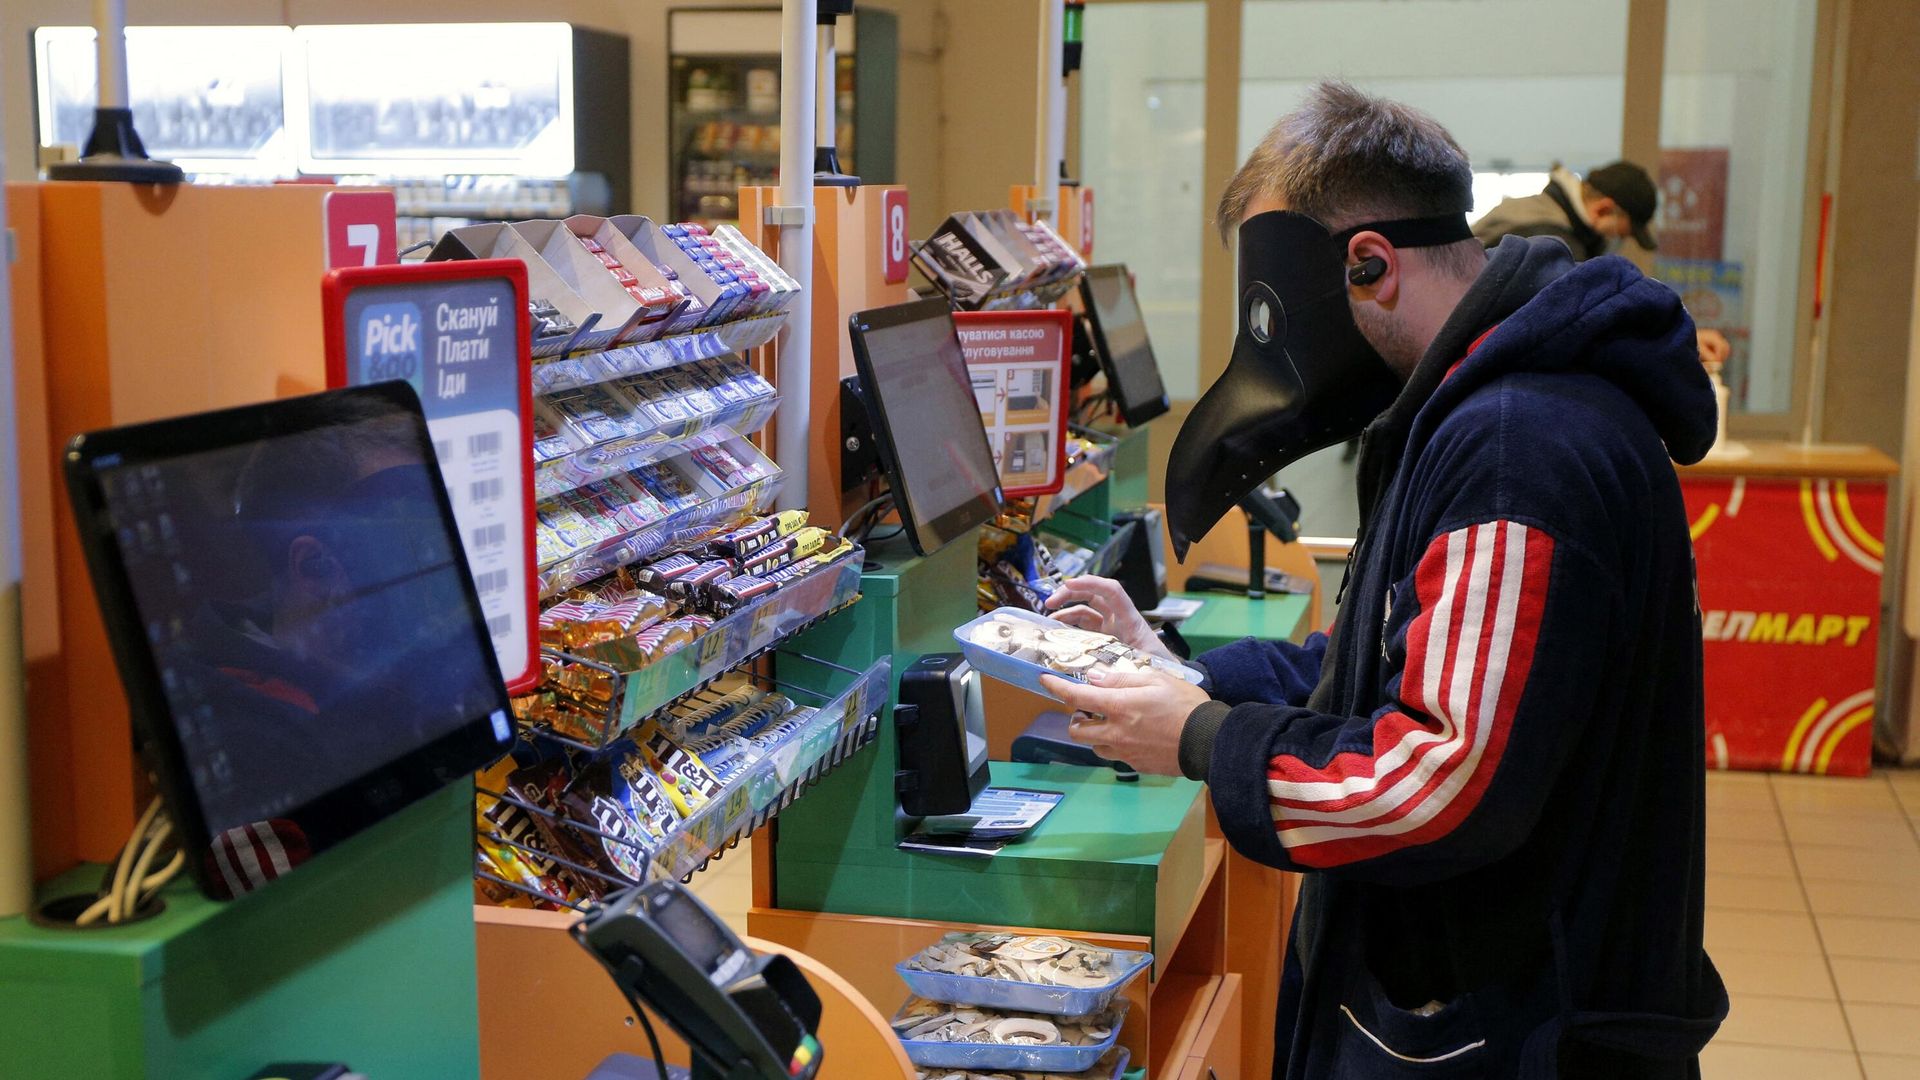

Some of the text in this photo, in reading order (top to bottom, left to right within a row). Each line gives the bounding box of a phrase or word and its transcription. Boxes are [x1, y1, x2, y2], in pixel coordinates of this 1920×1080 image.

[347, 223, 379, 267] 7
[892, 205, 904, 262] 8
[933, 231, 994, 284] HALLS
[365, 314, 418, 356] Pick
[436, 297, 498, 335] Скануй
[1009, 328, 1045, 339] касою
[436, 336, 490, 364] Плати
[437, 369, 466, 399] Іди
[1702, 610, 1871, 647] ЕЛМАРТ
